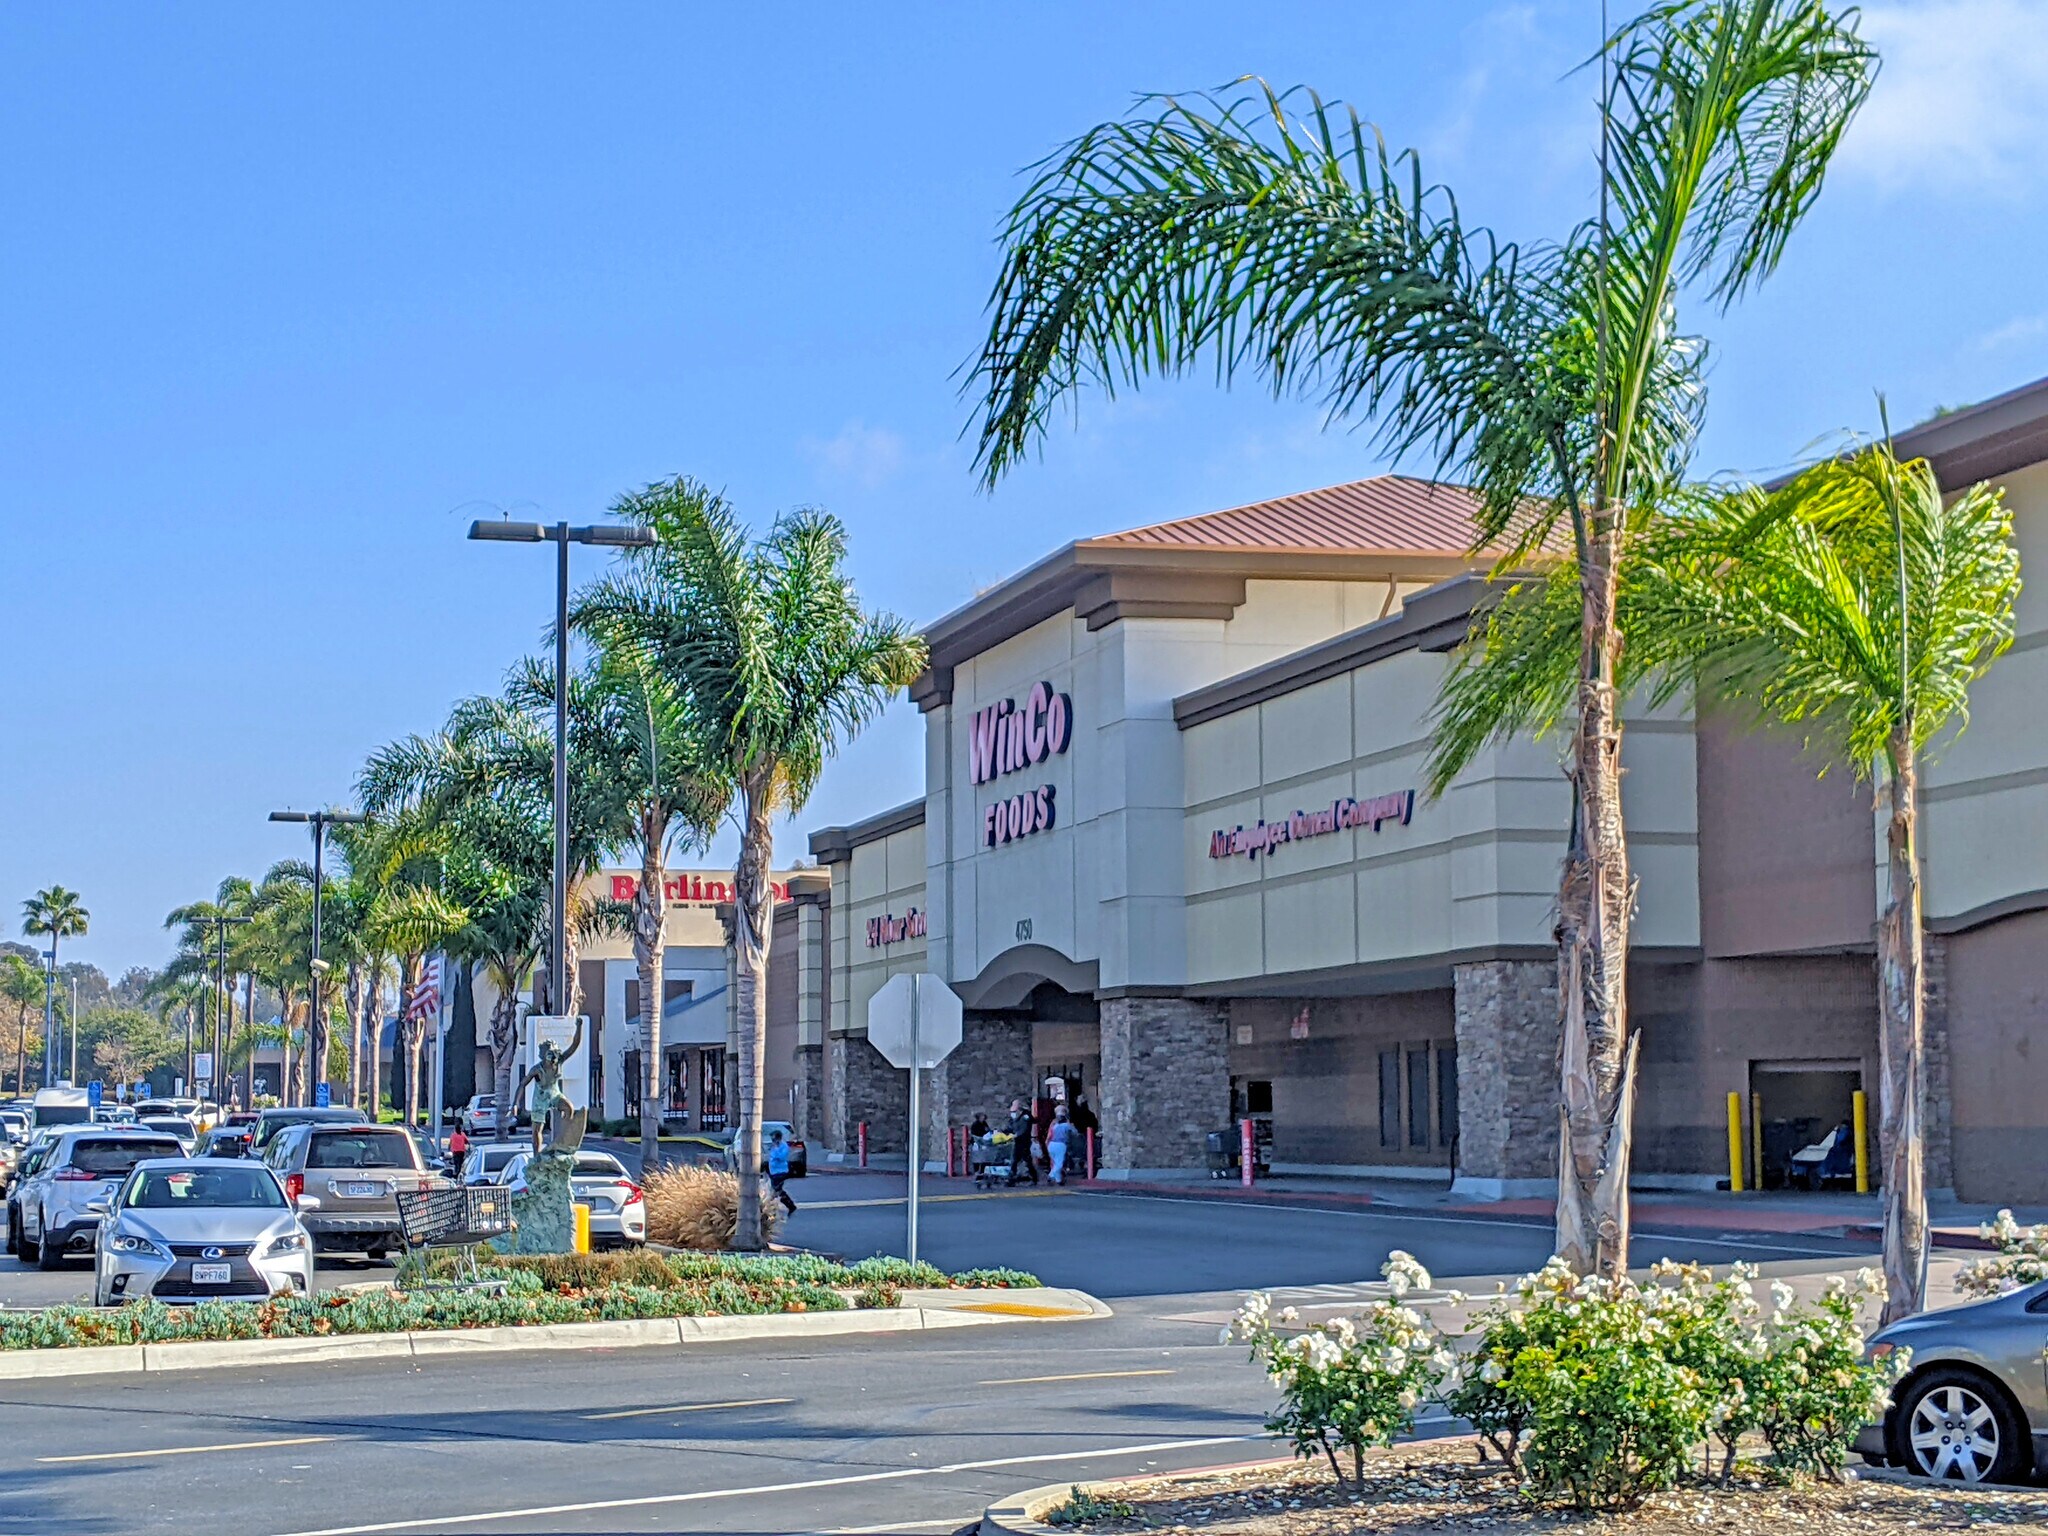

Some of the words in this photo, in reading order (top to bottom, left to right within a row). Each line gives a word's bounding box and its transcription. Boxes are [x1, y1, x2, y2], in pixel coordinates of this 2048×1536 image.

[969, 681, 1072, 785] WinCo
[984, 784, 1056, 847] FOODS
[1209, 828, 1229, 858] An
[1228, 820, 1290, 859] Employee
[1289, 800, 1340, 840] Owned
[1337, 789, 1415, 832] Company
